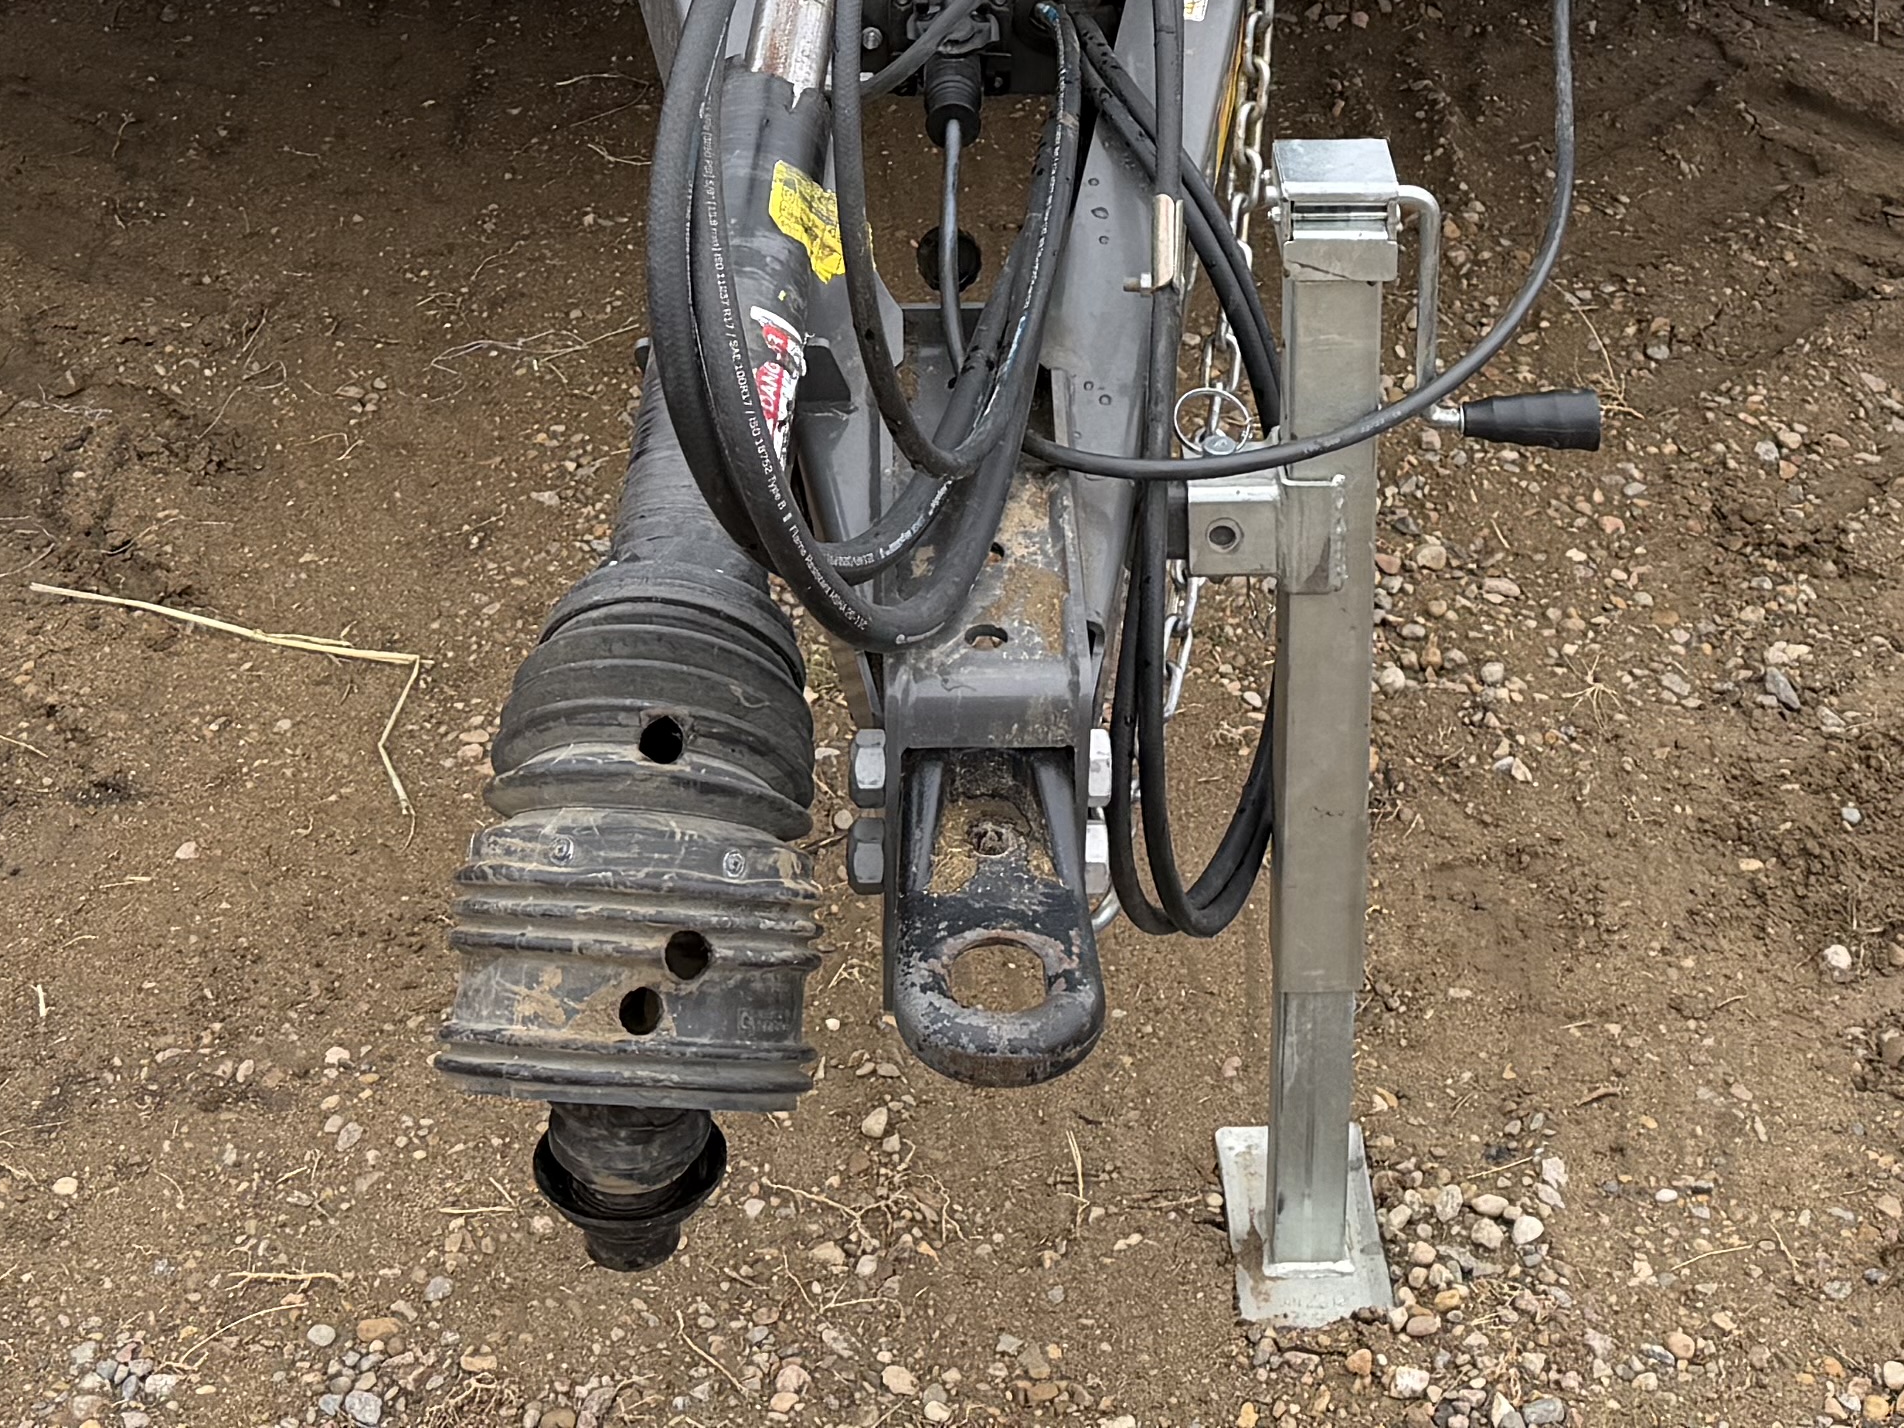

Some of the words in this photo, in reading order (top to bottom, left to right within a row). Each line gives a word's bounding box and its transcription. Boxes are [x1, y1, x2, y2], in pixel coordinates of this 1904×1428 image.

[712, 252, 724, 271] ISO
[722, 308, 734, 329] R17
[728, 340, 741, 362] SAE
[734, 364, 753, 407] 100R17
[748, 416, 761, 437] ISO
